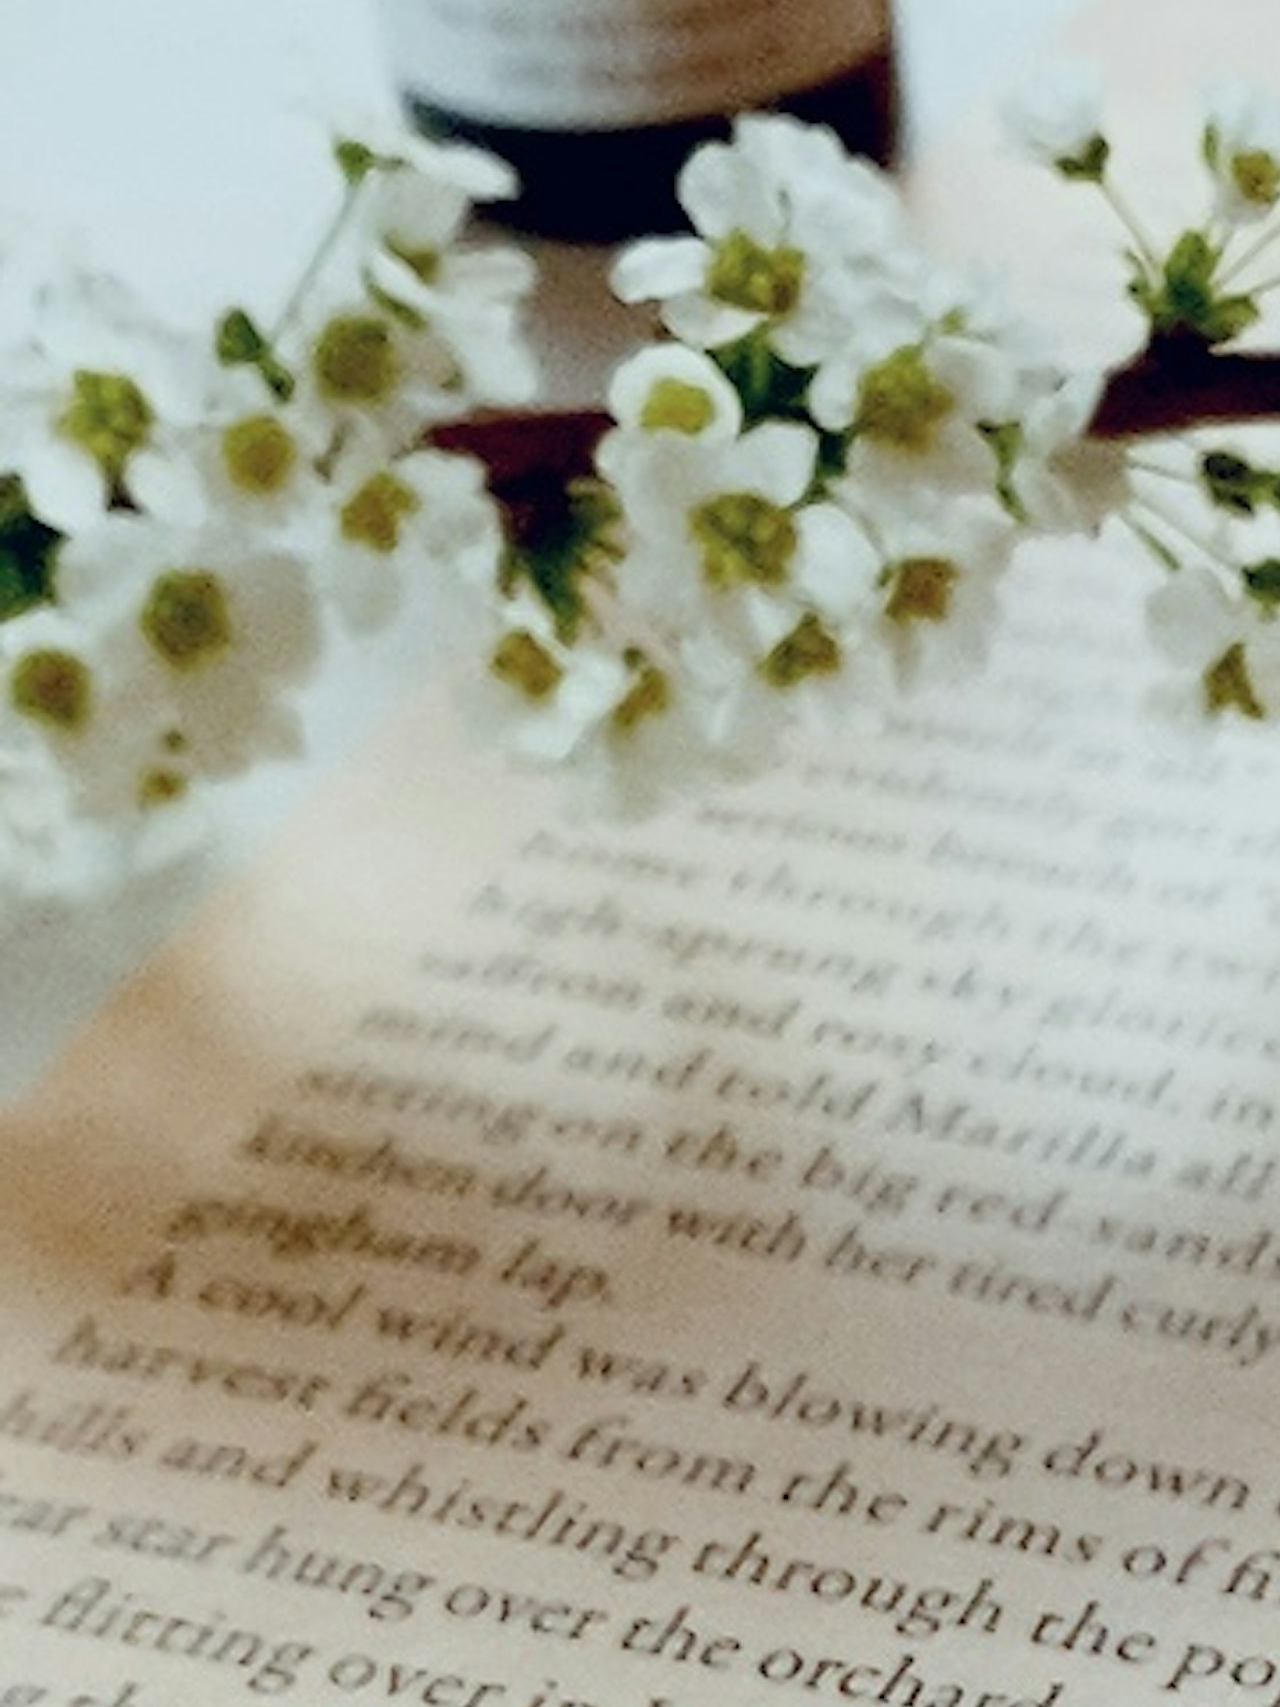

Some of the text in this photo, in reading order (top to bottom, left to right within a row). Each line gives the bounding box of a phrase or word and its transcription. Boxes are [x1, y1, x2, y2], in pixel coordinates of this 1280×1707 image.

[377, 1308, 567, 1370] wind
[579, 1347, 698, 1397] was
[722, 1362, 1026, 1478] blowing
[1041, 1430, 1251, 1511] down
[42, 1580, 314, 1693] flitting
